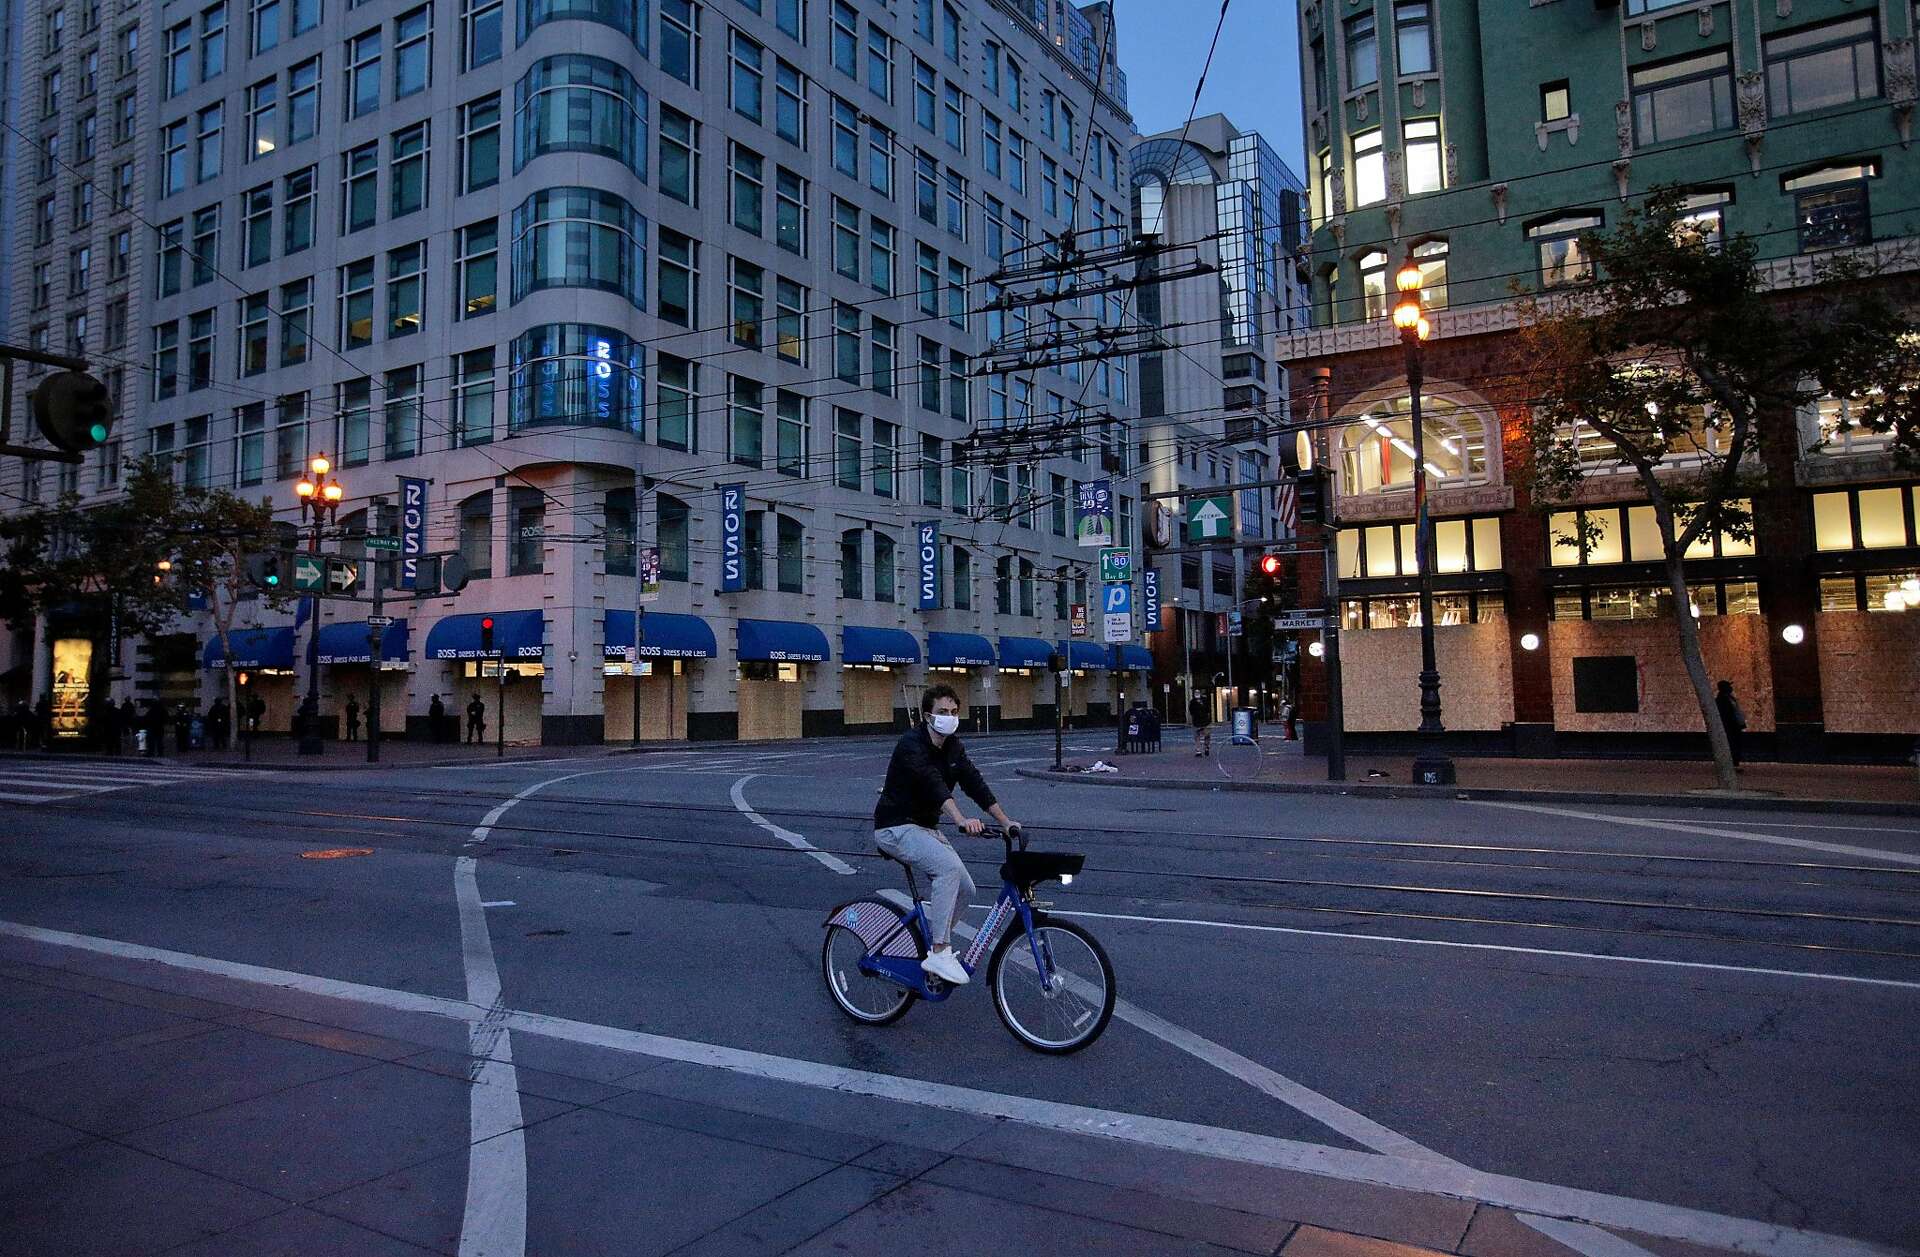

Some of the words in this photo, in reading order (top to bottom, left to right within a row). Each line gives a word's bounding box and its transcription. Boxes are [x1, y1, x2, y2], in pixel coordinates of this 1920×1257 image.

[595, 341, 612, 418] ROSS
[404, 484, 421, 578] ROSS
[725, 490, 740, 580] ROSS
[921, 526, 935, 600] ROSS
[1114, 557, 1126, 566] 80
[1146, 572, 1157, 625] ROSS
[1282, 620, 1316, 628] MARKET
[437, 649, 456, 658] ROSS
[518, 646, 543, 656] ROSS
[605, 645, 626, 655] ROSS
[640, 646, 661, 656] ROSS
[770, 651, 786, 660] ROSS
[872, 654, 886, 662] ROSS
